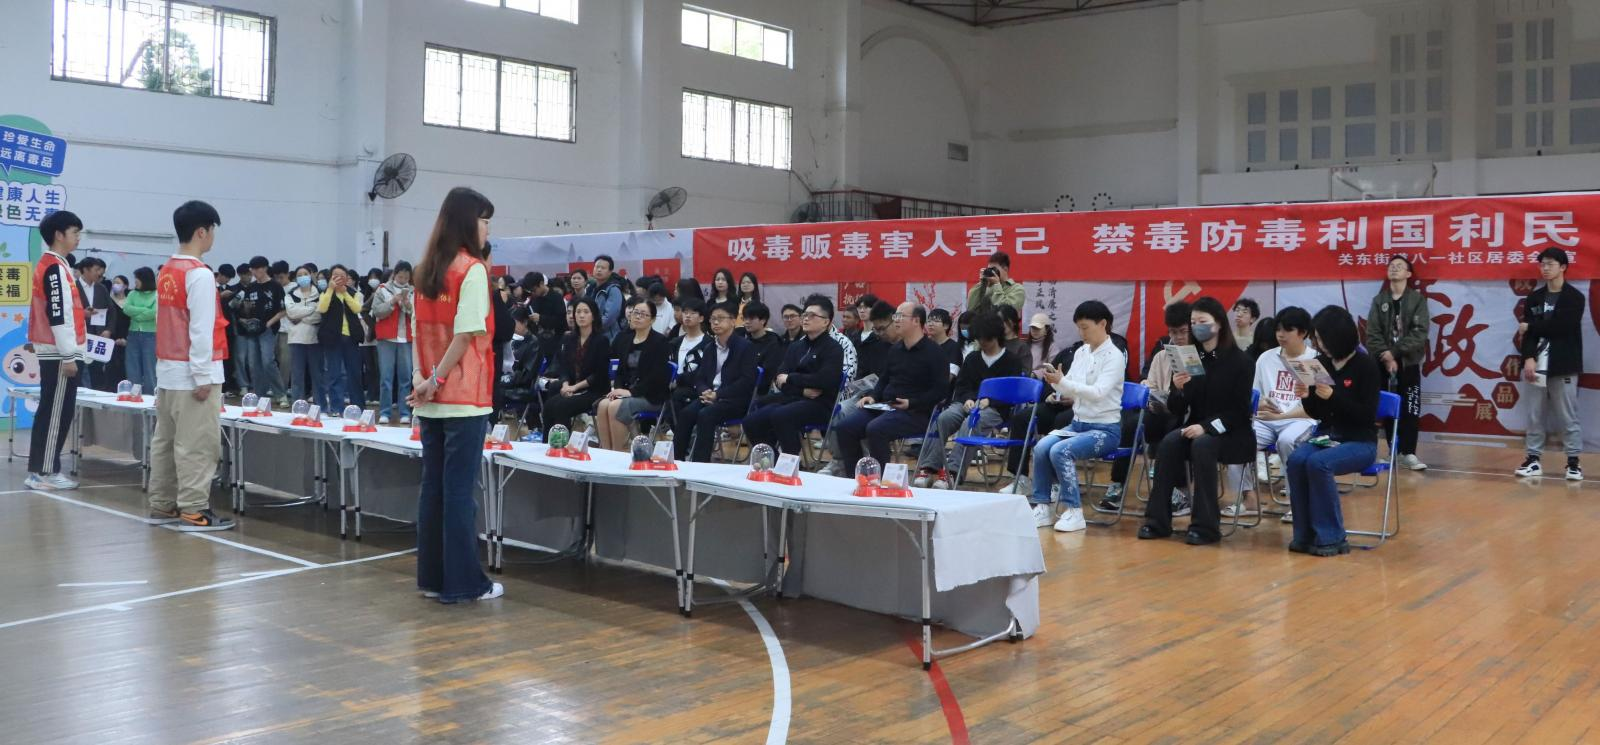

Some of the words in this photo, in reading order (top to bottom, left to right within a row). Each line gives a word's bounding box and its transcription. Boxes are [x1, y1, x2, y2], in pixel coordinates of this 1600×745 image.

[3, 131, 55, 152] 珍爱生命
[0, 147, 53, 168] 远离毒品
[0, 186, 60, 205] 康人生
[727, 226, 1050, 262] 吸毒贩毒害人害己
[1092, 211, 1581, 255] 禁毒防毒利国利民
[0, 267, 21, 281] 毒
[0, 284, 21, 298] 福
